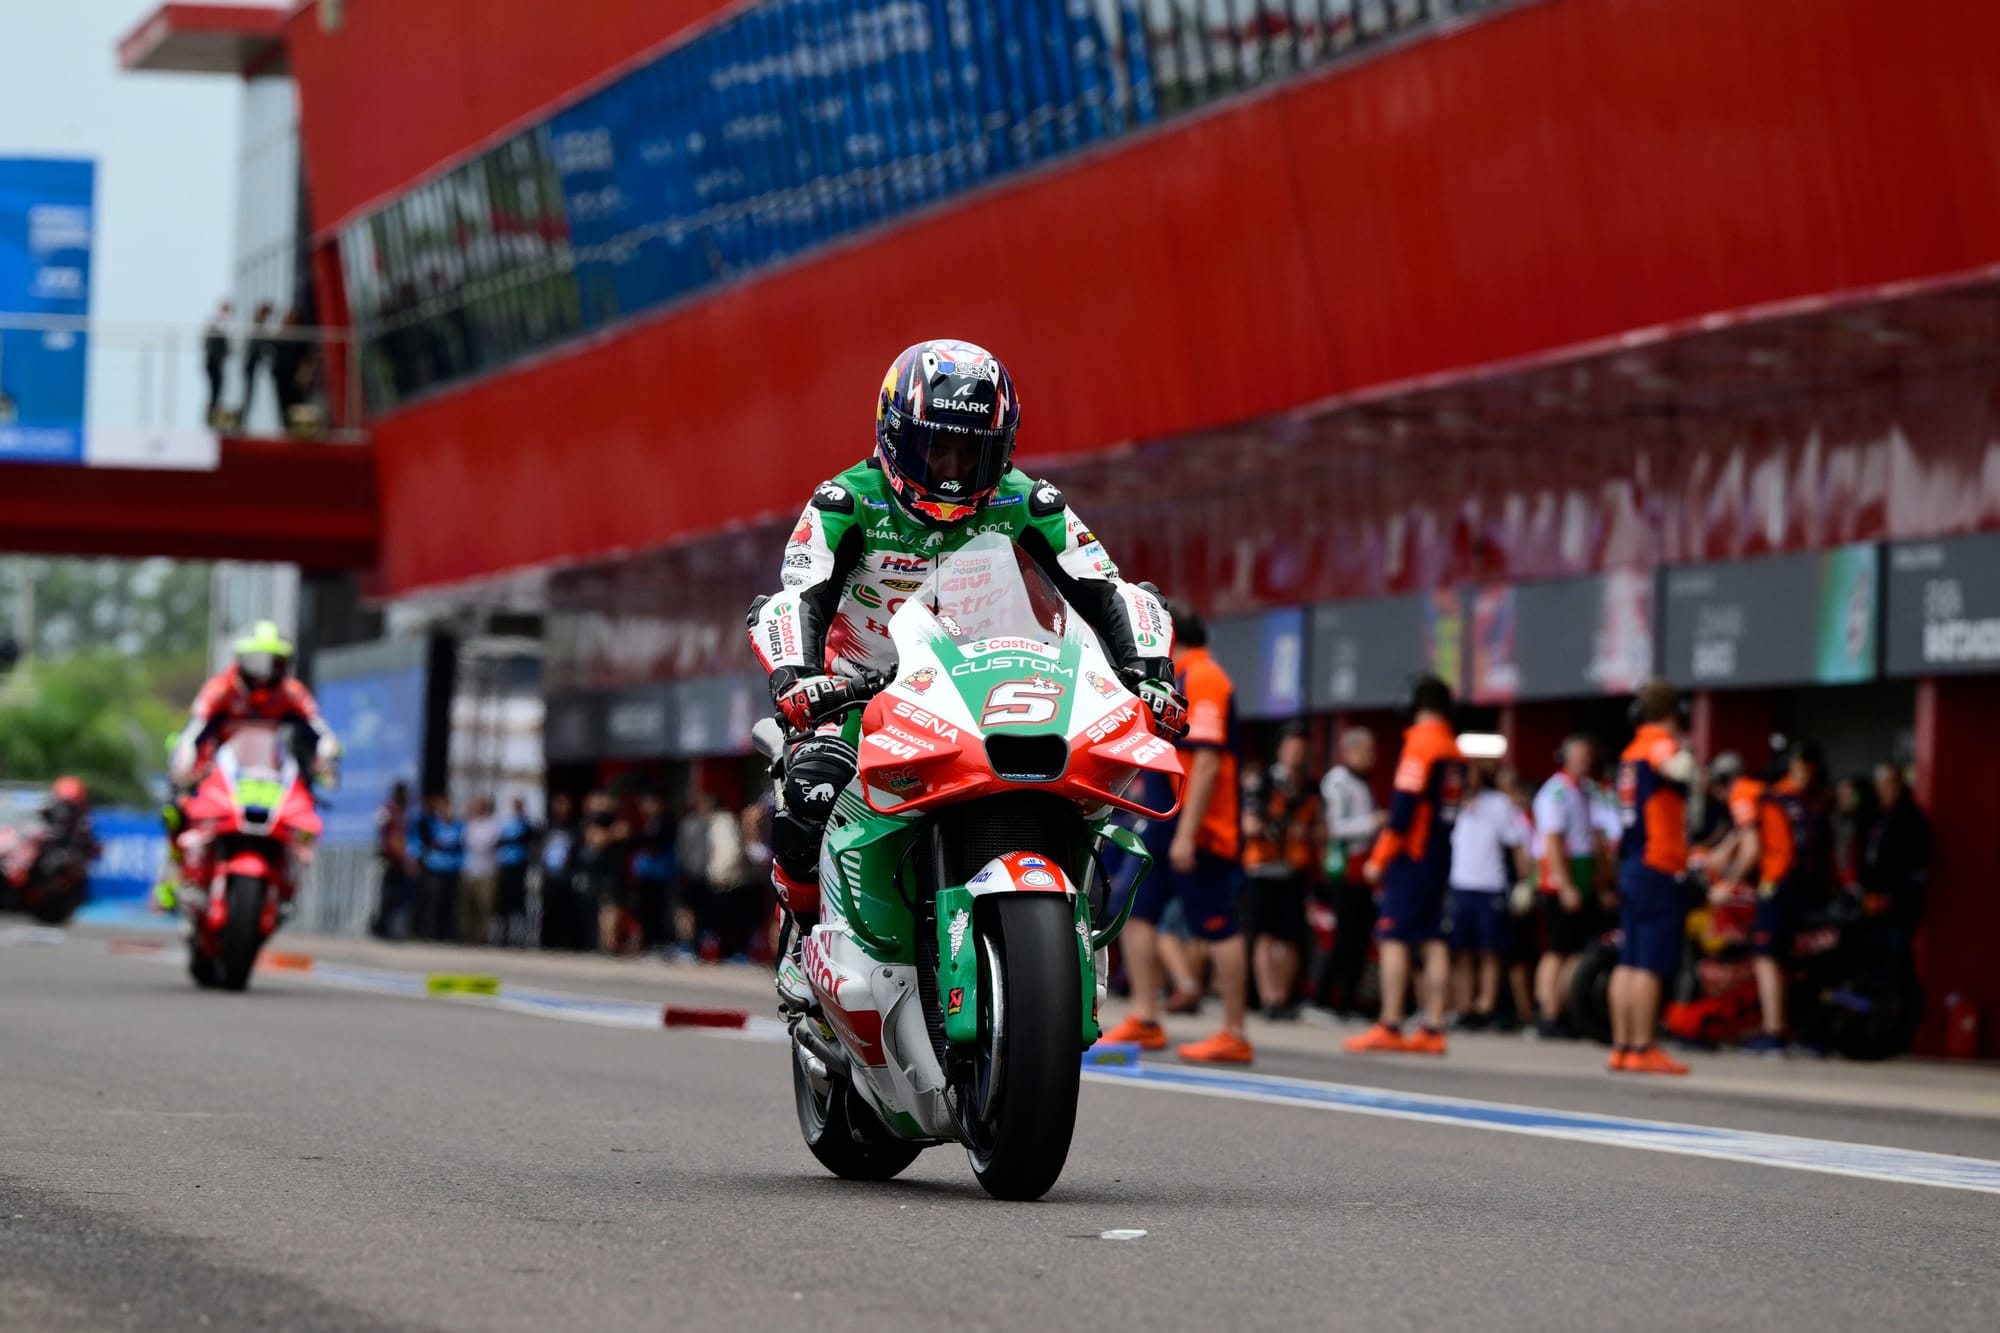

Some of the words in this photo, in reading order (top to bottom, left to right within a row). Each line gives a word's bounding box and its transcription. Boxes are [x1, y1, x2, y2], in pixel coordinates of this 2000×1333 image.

[932, 398, 990, 414] SHARK
[912, 418, 941, 431] GIVES
[947, 425, 969, 434] YOU
[974, 428, 1004, 437] WINGS
[940, 481, 962, 493] Dafy
[880, 556, 930, 572] HRC
[954, 556, 992, 568] Castrol
[941, 573, 992, 592] GIVI
[1131, 591, 1151, 631] Castrol
[766, 619, 783, 662] POWER1
[780, 614, 798, 656] Castrol
[989, 638, 1043, 653] Castrol
[952, 656, 1074, 678] CUSTOM
[979, 676, 1066, 729] 5
[892, 702, 959, 744] SENA
[1086, 705, 1138, 743] SENA
[865, 733, 920, 760] GIVI
[885, 725, 935, 752] HONDA
[1108, 731, 1147, 755] HONDA
[1131, 736, 1173, 765] GIVI
